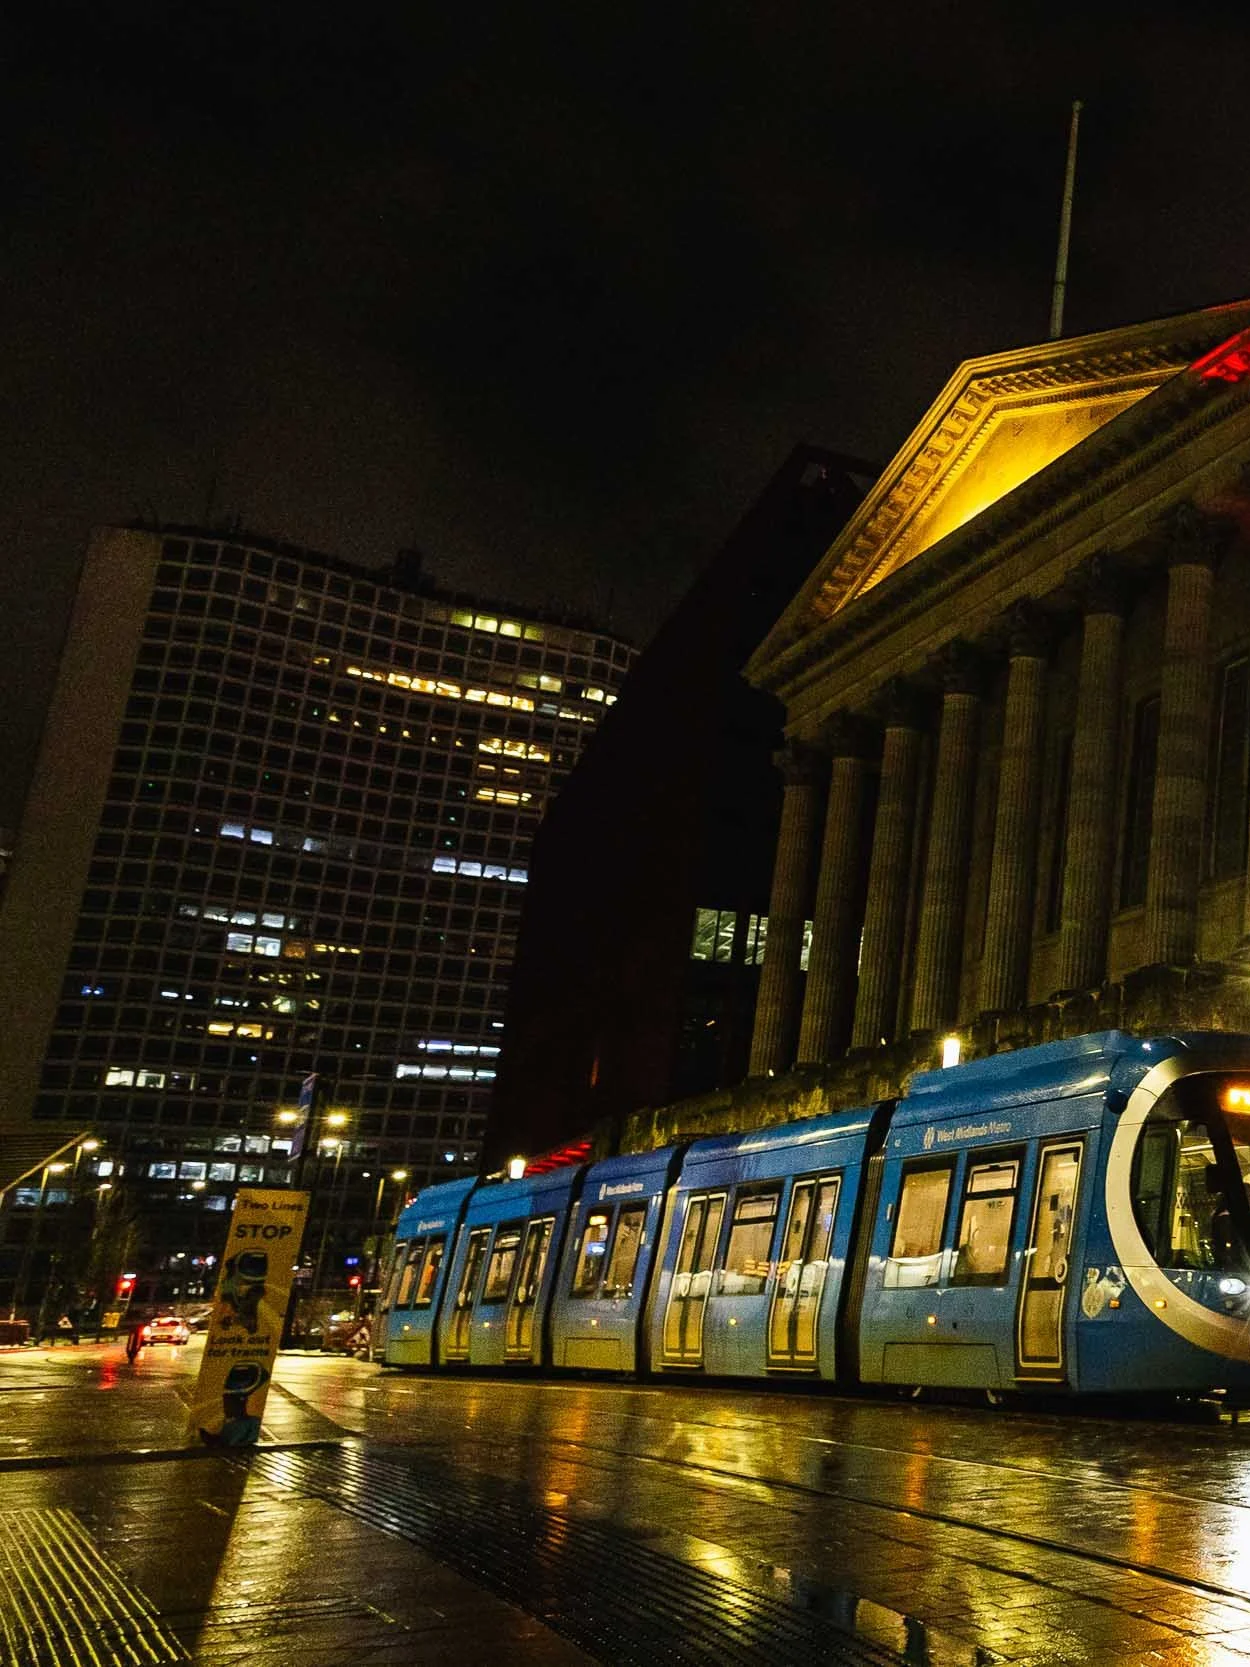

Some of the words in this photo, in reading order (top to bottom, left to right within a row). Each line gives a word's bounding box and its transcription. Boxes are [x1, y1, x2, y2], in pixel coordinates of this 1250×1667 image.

[937, 1128, 955, 1142] West
[955, 1123, 988, 1140] Midlands
[989, 1120, 1012, 1134] Metro
[240, 1200, 269, 1210] Two
[271, 1201, 304, 1212] Lines
[235, 1224, 293, 1239] STOP
[211, 1334, 243, 1345] Look
